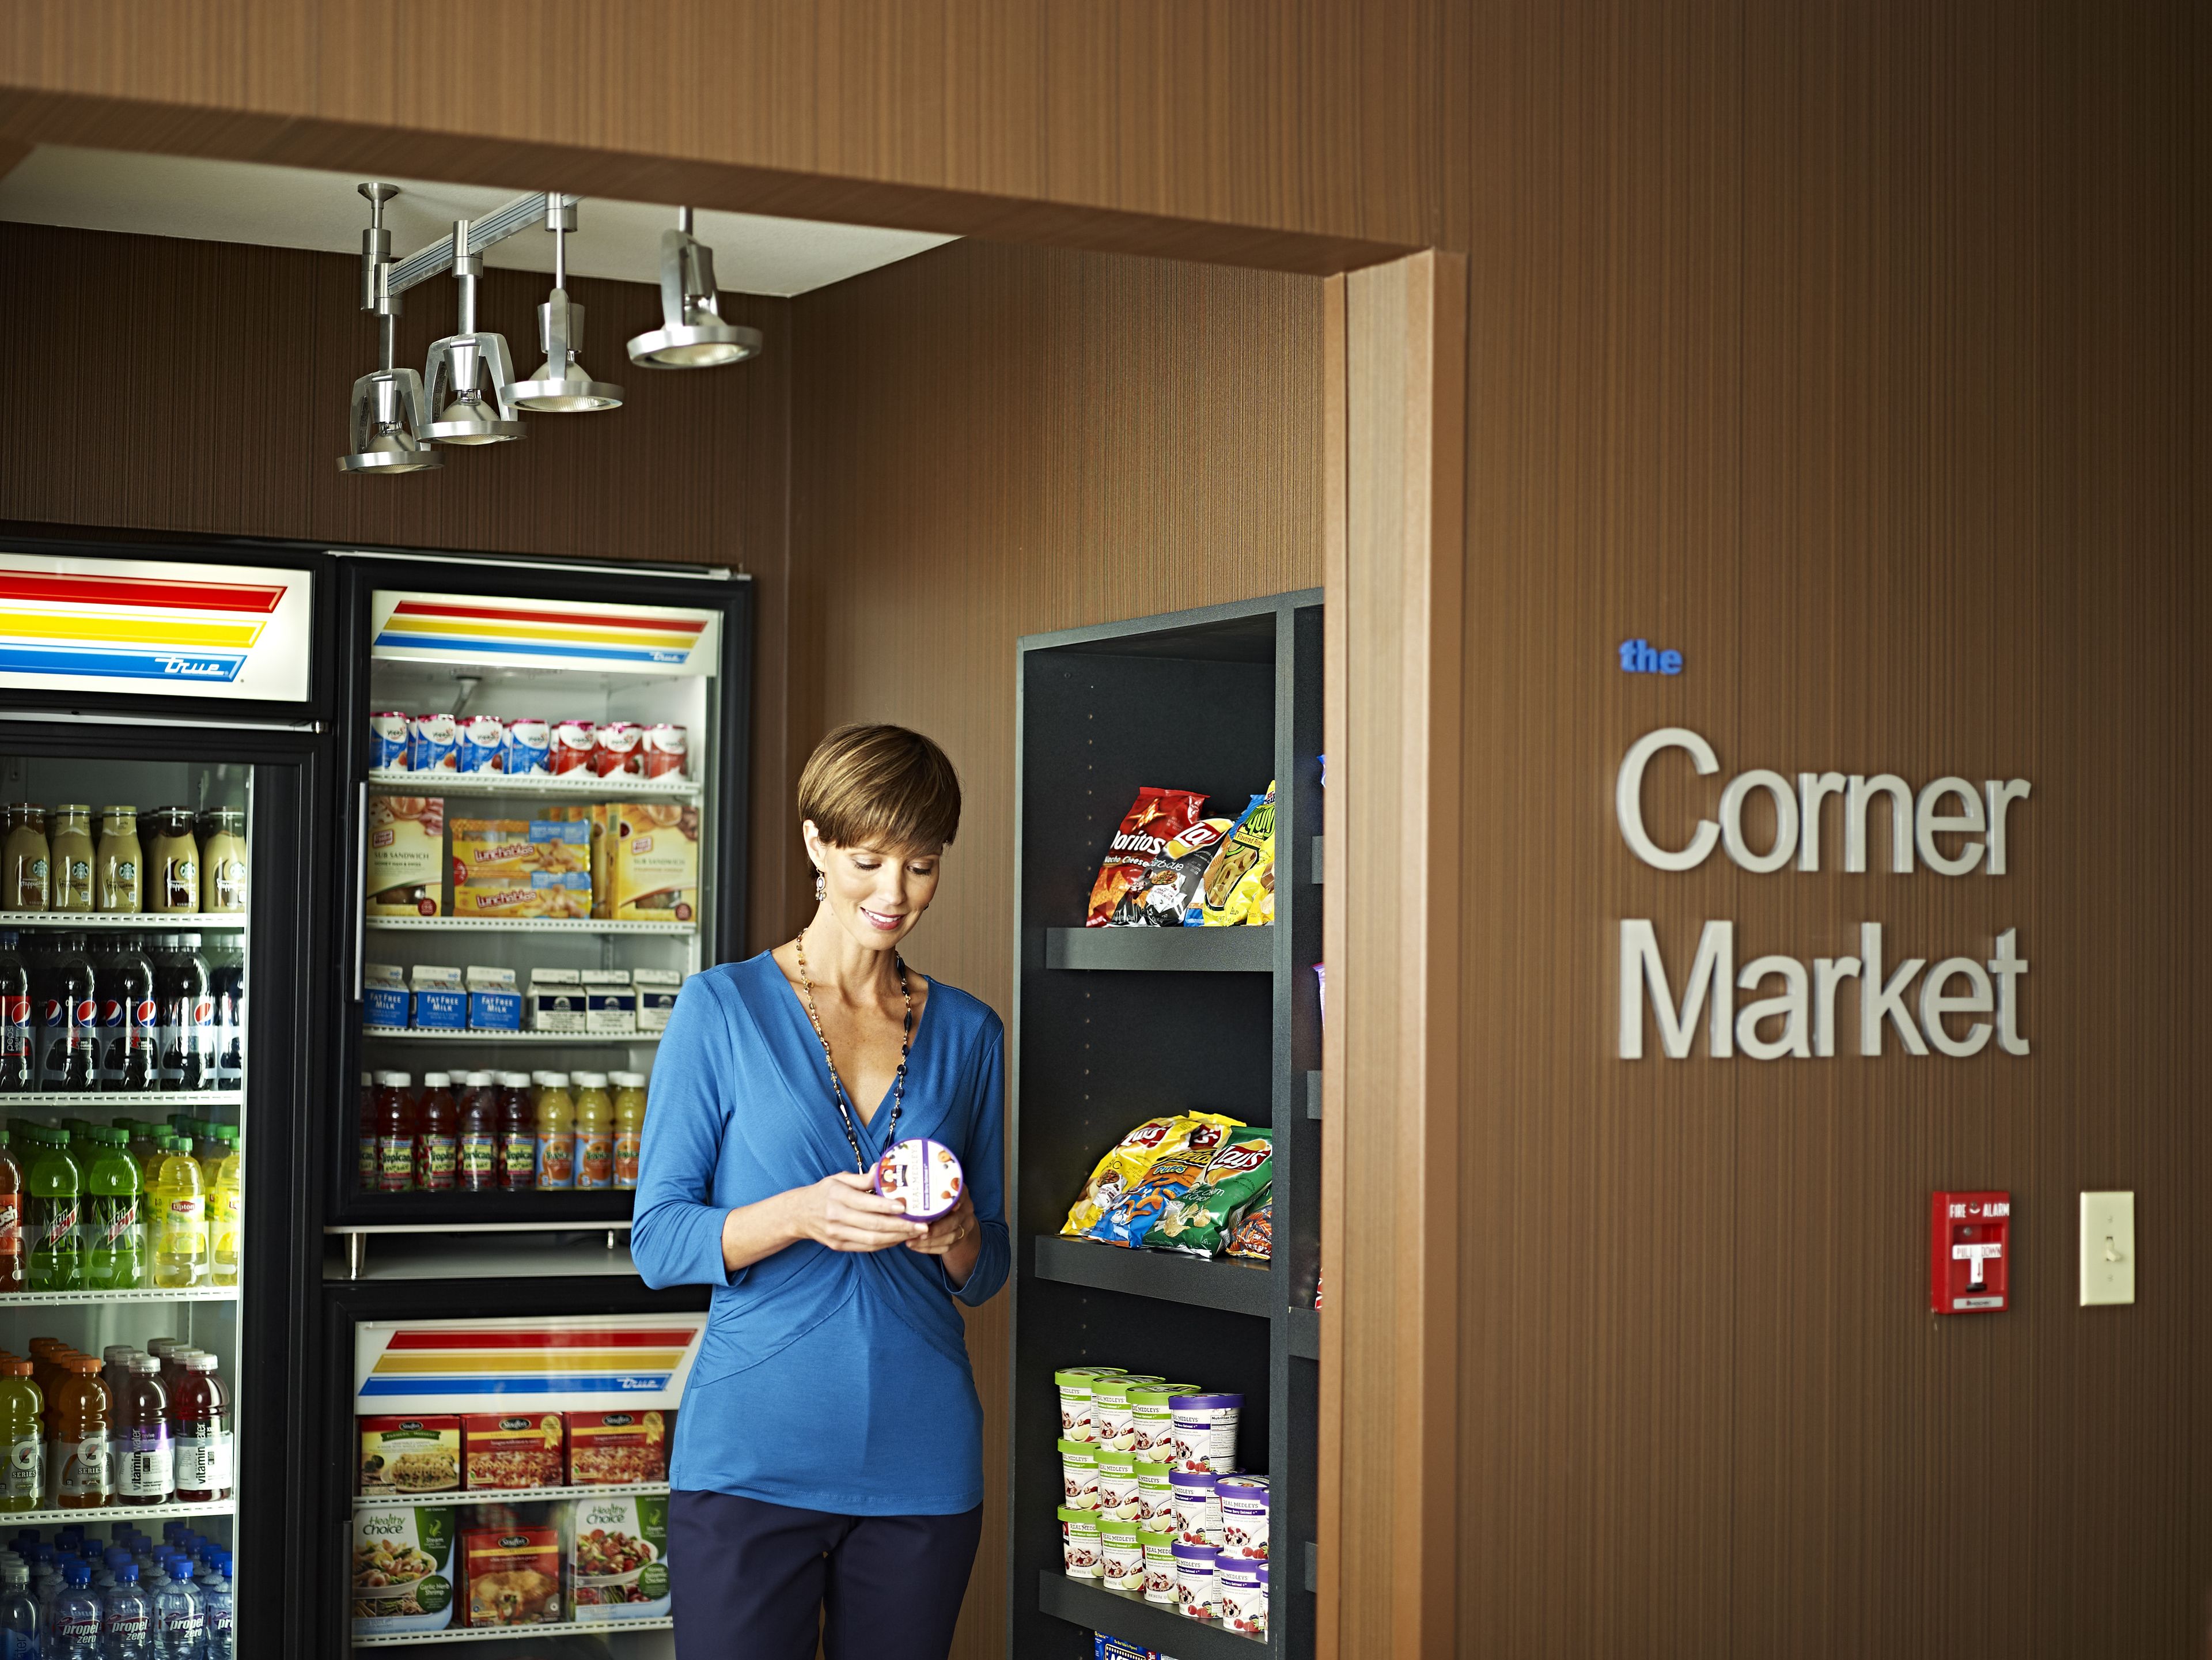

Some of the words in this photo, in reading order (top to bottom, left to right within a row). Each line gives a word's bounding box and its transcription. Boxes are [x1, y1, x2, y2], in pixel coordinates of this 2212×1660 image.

[1619, 639, 1682, 675] the
[1616, 727, 2032, 876] Corner
[474, 842, 535, 863] Lunchables
[1122, 856, 1148, 867] Cheese
[476, 889, 537, 909] Lunchables
[1619, 918, 2031, 1060] Market
[370, 993, 382, 1001] FAT
[384, 994, 401, 1003] FREE
[427, 995, 440, 1004] FAT
[441, 996, 459, 1005] FREE
[482, 996, 495, 1005] FAT
[495, 997, 513, 1007] FREE
[375, 1001, 395, 1011] MILK
[433, 1004, 452, 1012] MILK
[487, 1005, 507, 1013] MILK
[1207, 1145, 1267, 1171] Lay's
[912, 1187, 921, 1209] REAL
[173, 1203, 195, 1211] Lipton
[1949, 1204, 1967, 1218] FIRE
[1982, 1203, 2010, 1217] ALARM
[0, 1205, 18, 1227] ush
[1957, 1246, 1973, 1258] PULL
[1981, 1246, 2002, 1257] DOWN
[593, 1503, 628, 1514] Healthy
[369, 1513, 406, 1526] Healthy
[586, 1513, 626, 1525] Choice
[363, 1524, 404, 1536] Choice
[62, 1622, 99, 1636] propel
[112, 1619, 147, 1633] propel
[169, 1616, 204, 1631] propel
[77, 1635, 96, 1644] zero
[126, 1632, 146, 1641] zero
[184, 1628, 202, 1639] zero
